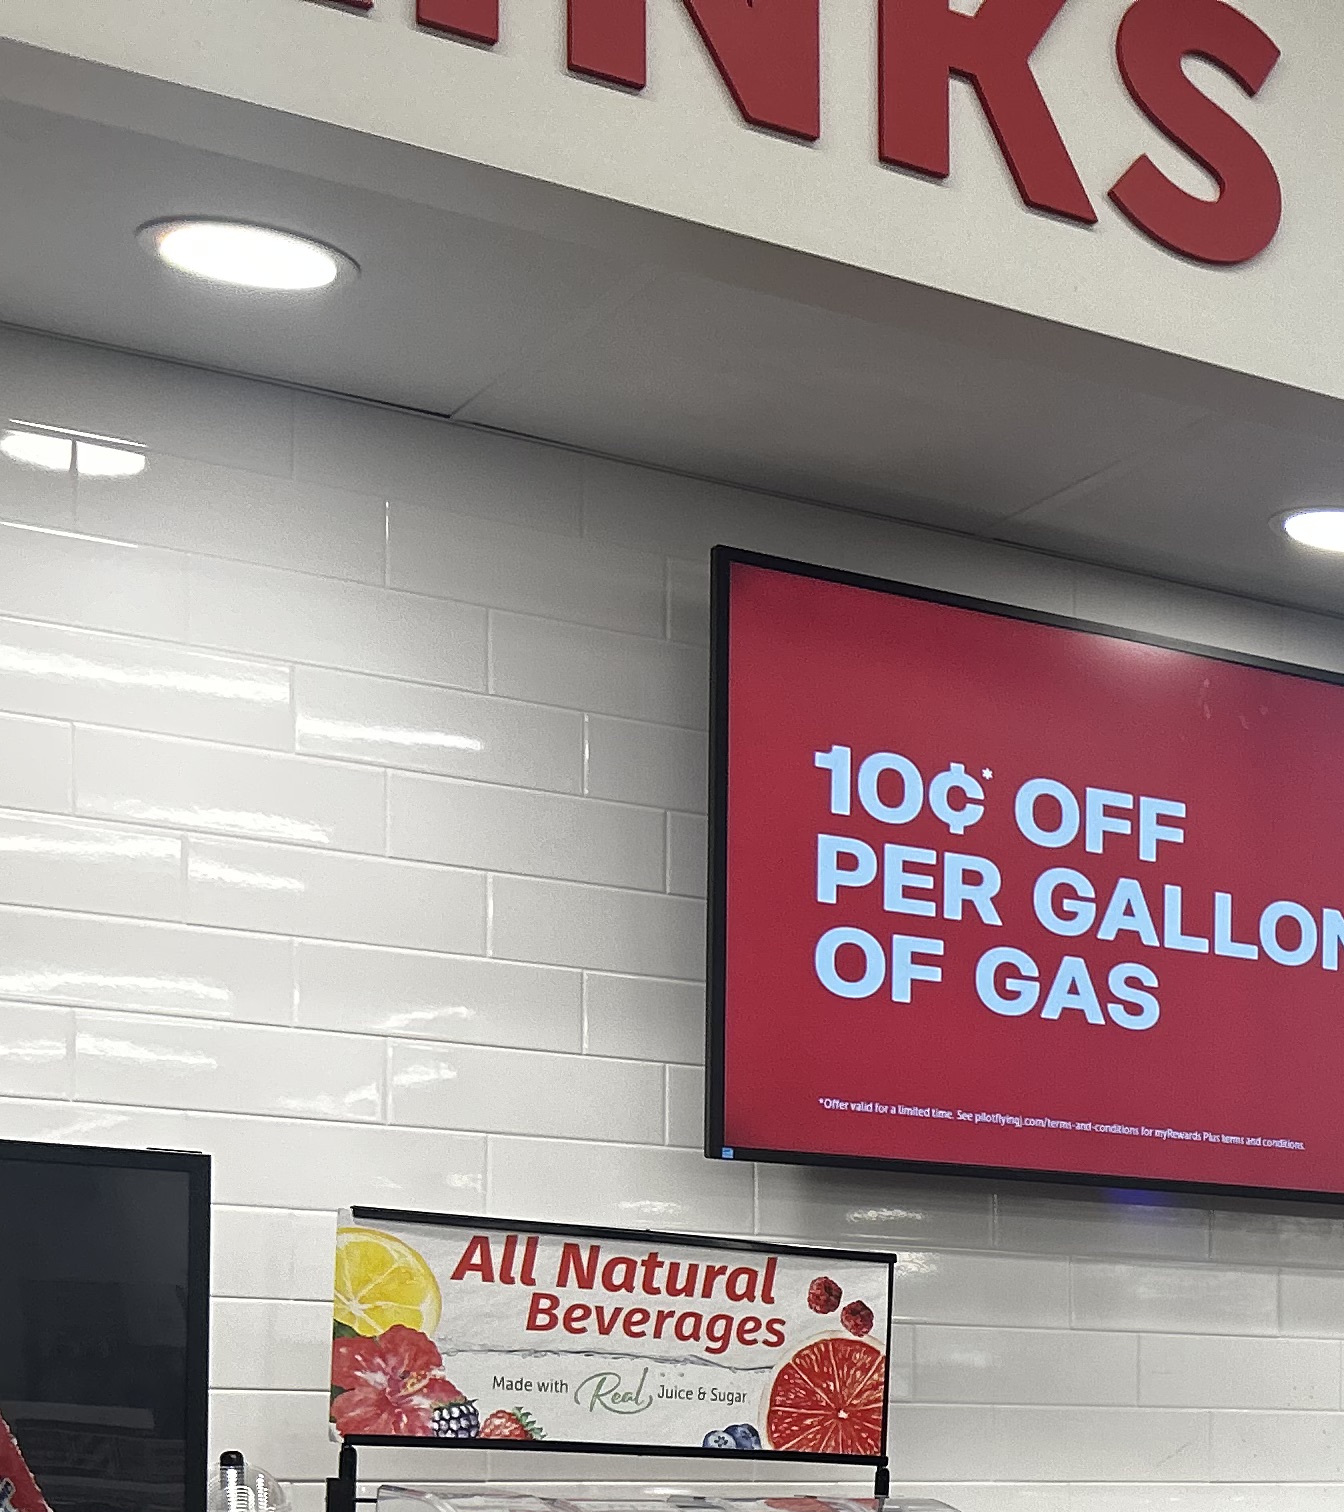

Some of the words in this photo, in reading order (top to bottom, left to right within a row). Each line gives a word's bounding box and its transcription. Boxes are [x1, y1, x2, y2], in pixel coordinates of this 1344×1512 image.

[1014, 778, 1186, 861] OFF
[816, 834, 1002, 925] PER
[814, 927, 943, 1003] OF
[975, 946, 1160, 1030] GAS
[850, 1102, 872, 1112] valid
[875, 1103, 888, 1114] for
[898, 1105, 930, 1118] limited
[957, 1110, 973, 1122] See
[451, 1234, 539, 1287] All
[556, 1242, 778, 1305] Natural
[526, 1292, 787, 1354] Beverages
[492, 1375, 533, 1393] Made
[536, 1377, 569, 1395] with
[573, 1367, 655, 1415] Real
[657, 1384, 693, 1402] Juice
[697, 1386, 706, 1401] &
[711, 1388, 747, 1407] Sugar
